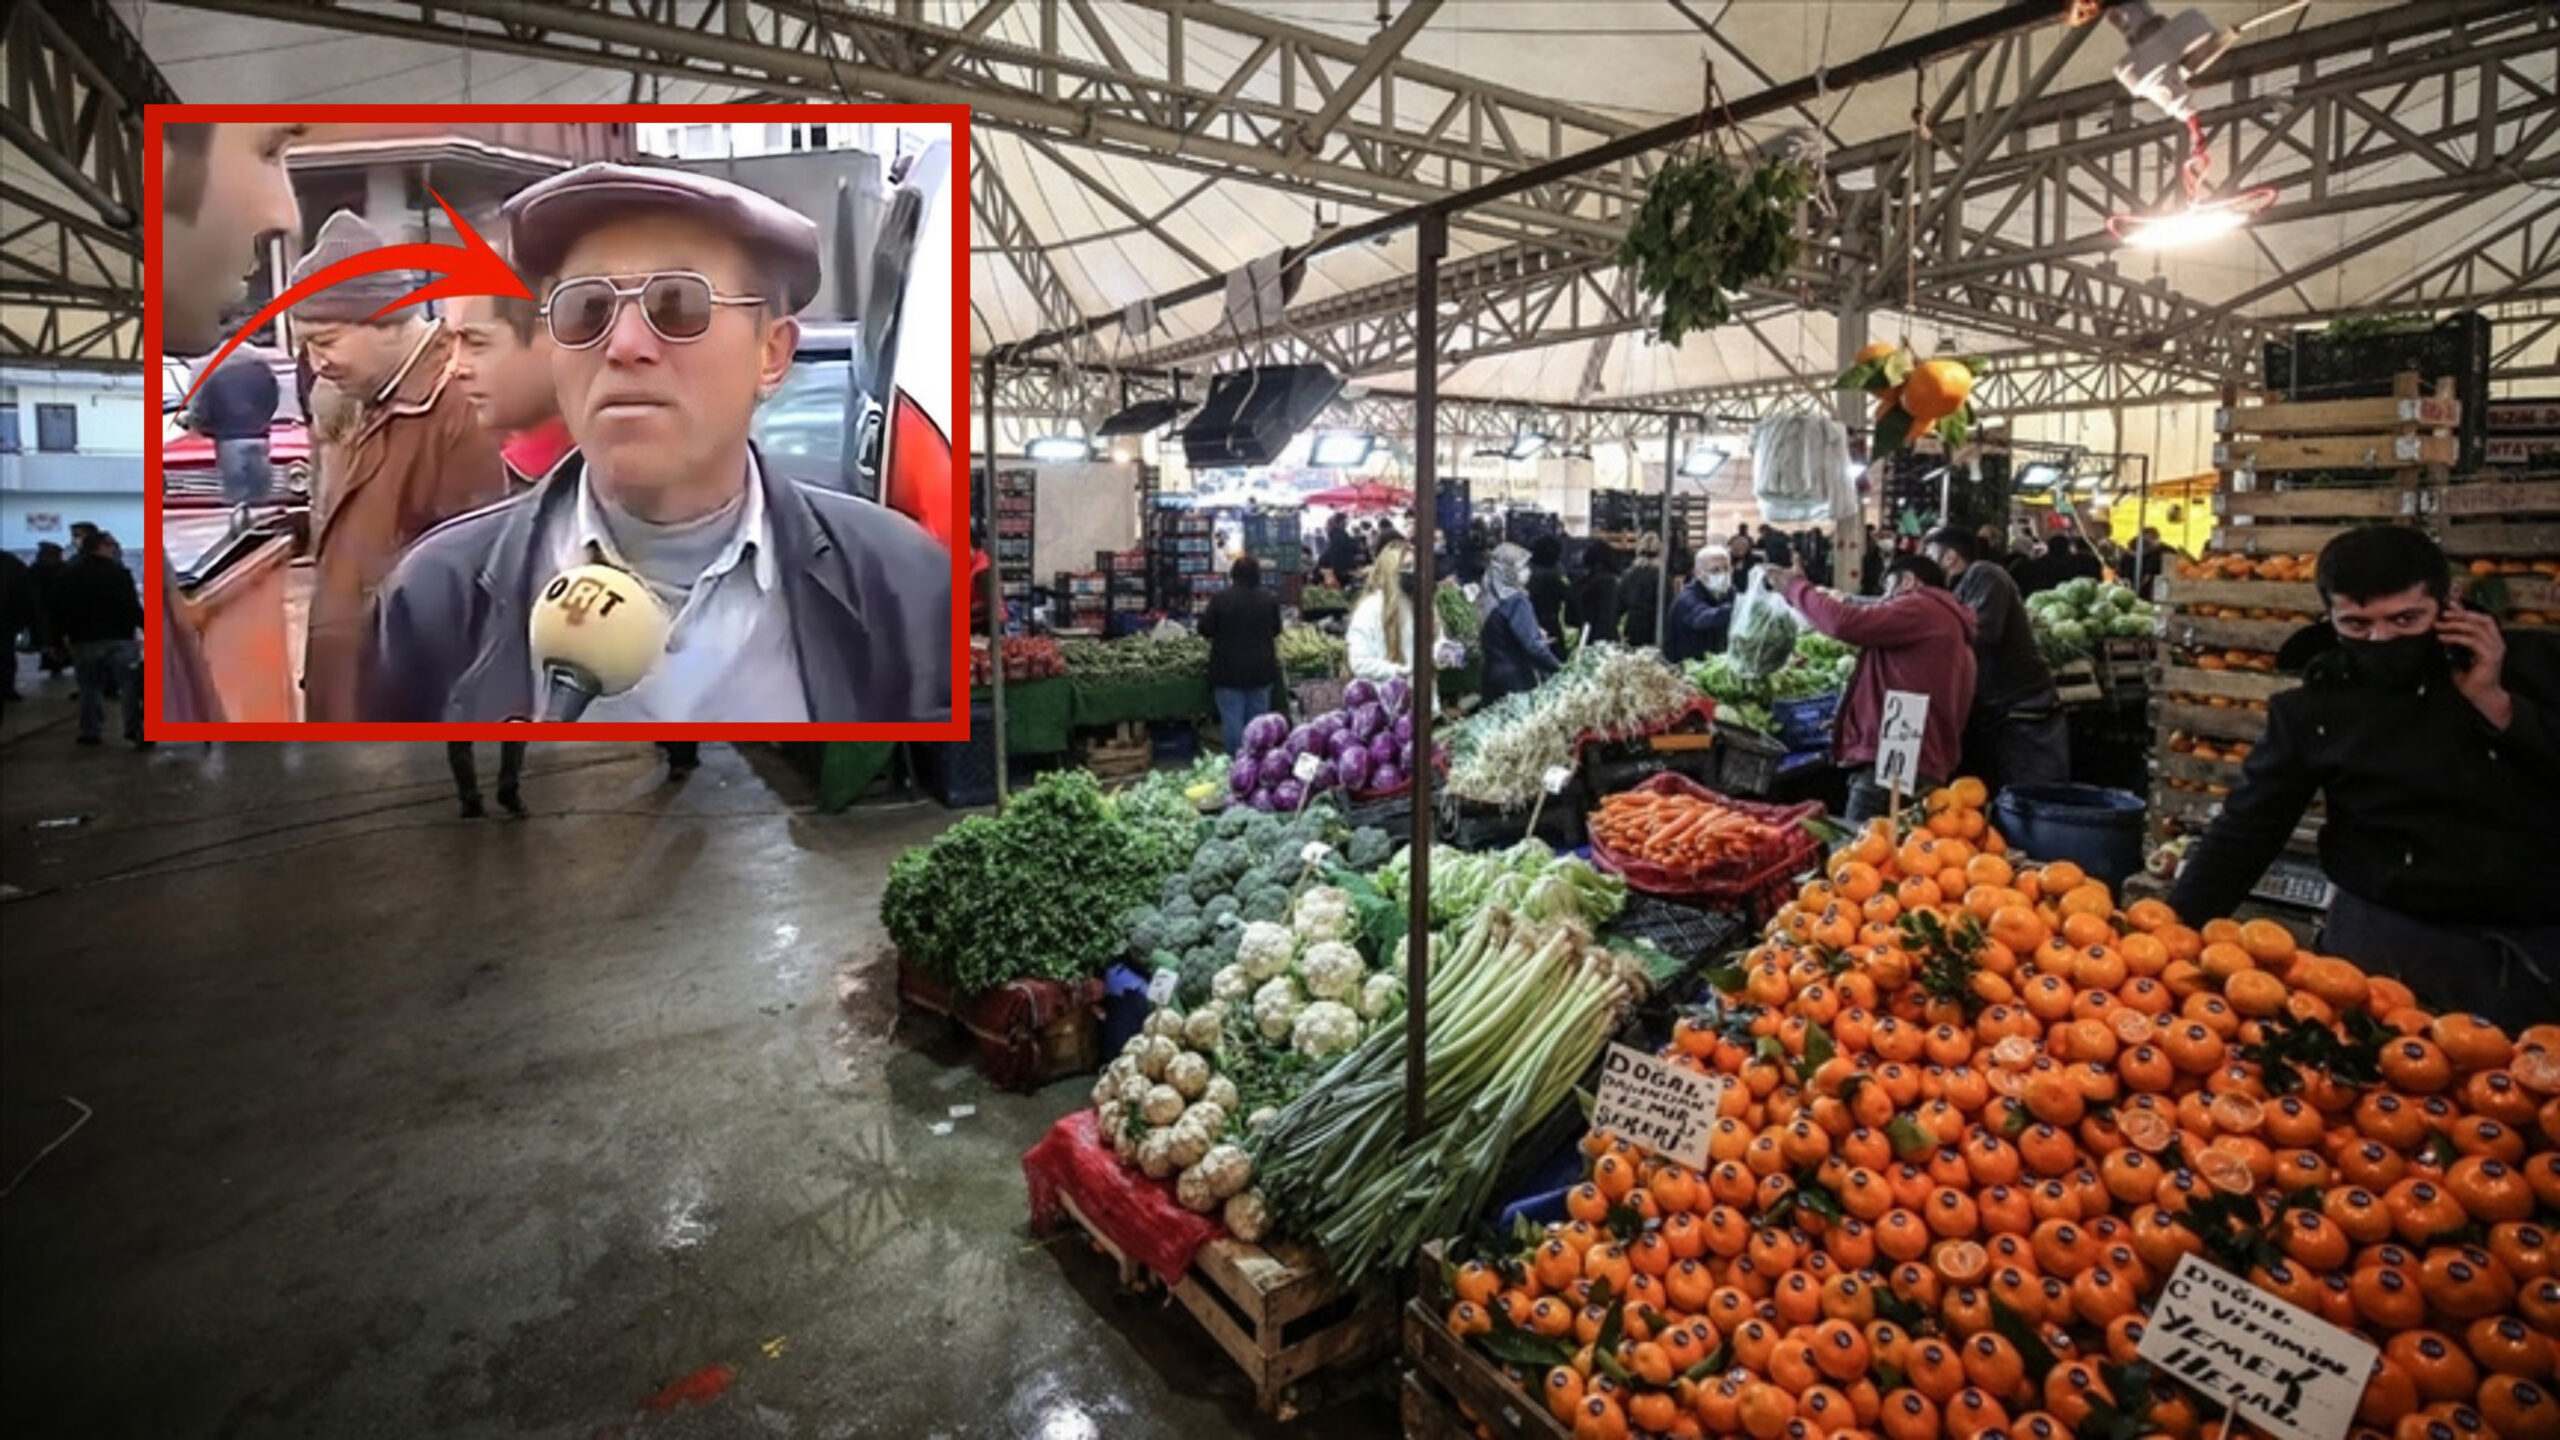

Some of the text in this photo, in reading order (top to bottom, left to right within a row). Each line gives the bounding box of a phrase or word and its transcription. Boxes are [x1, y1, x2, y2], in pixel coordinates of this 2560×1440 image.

[2167, 1279, 2192, 1300] C
[2159, 1305, 2322, 1408] YEMEK
[2162, 1347, 2298, 1427] HELAL
